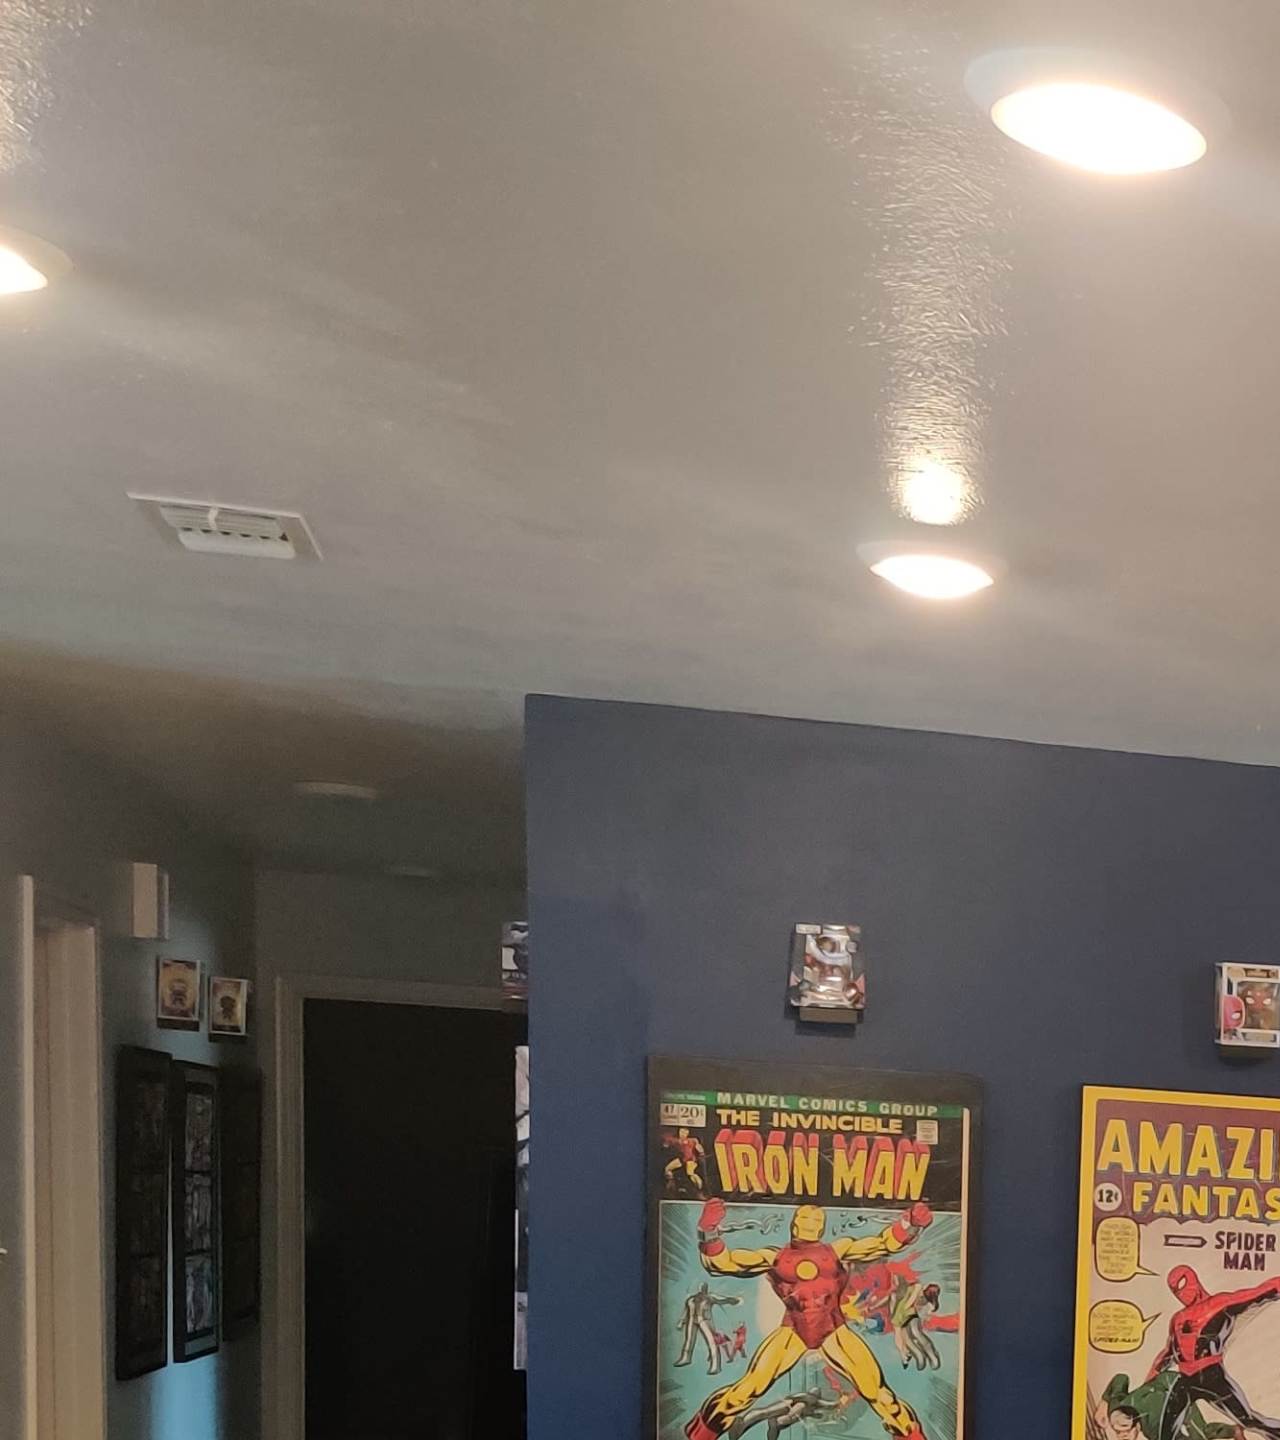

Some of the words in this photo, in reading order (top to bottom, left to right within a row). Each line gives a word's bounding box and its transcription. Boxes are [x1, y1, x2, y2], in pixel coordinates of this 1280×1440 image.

[717, 1092, 789, 1108] MARVEL
[798, 1098, 868, 1112] COMICS
[879, 1103, 938, 1116] GROUP
[716, 1109, 761, 1126] THE
[772, 1111, 904, 1134] INVINCIBLE
[714, 1128, 820, 1196] IRON
[832, 1133, 931, 1200] MAN
[1215, 1231, 1277, 1252] SPIDER
[1223, 1251, 1266, 1271] MAN
